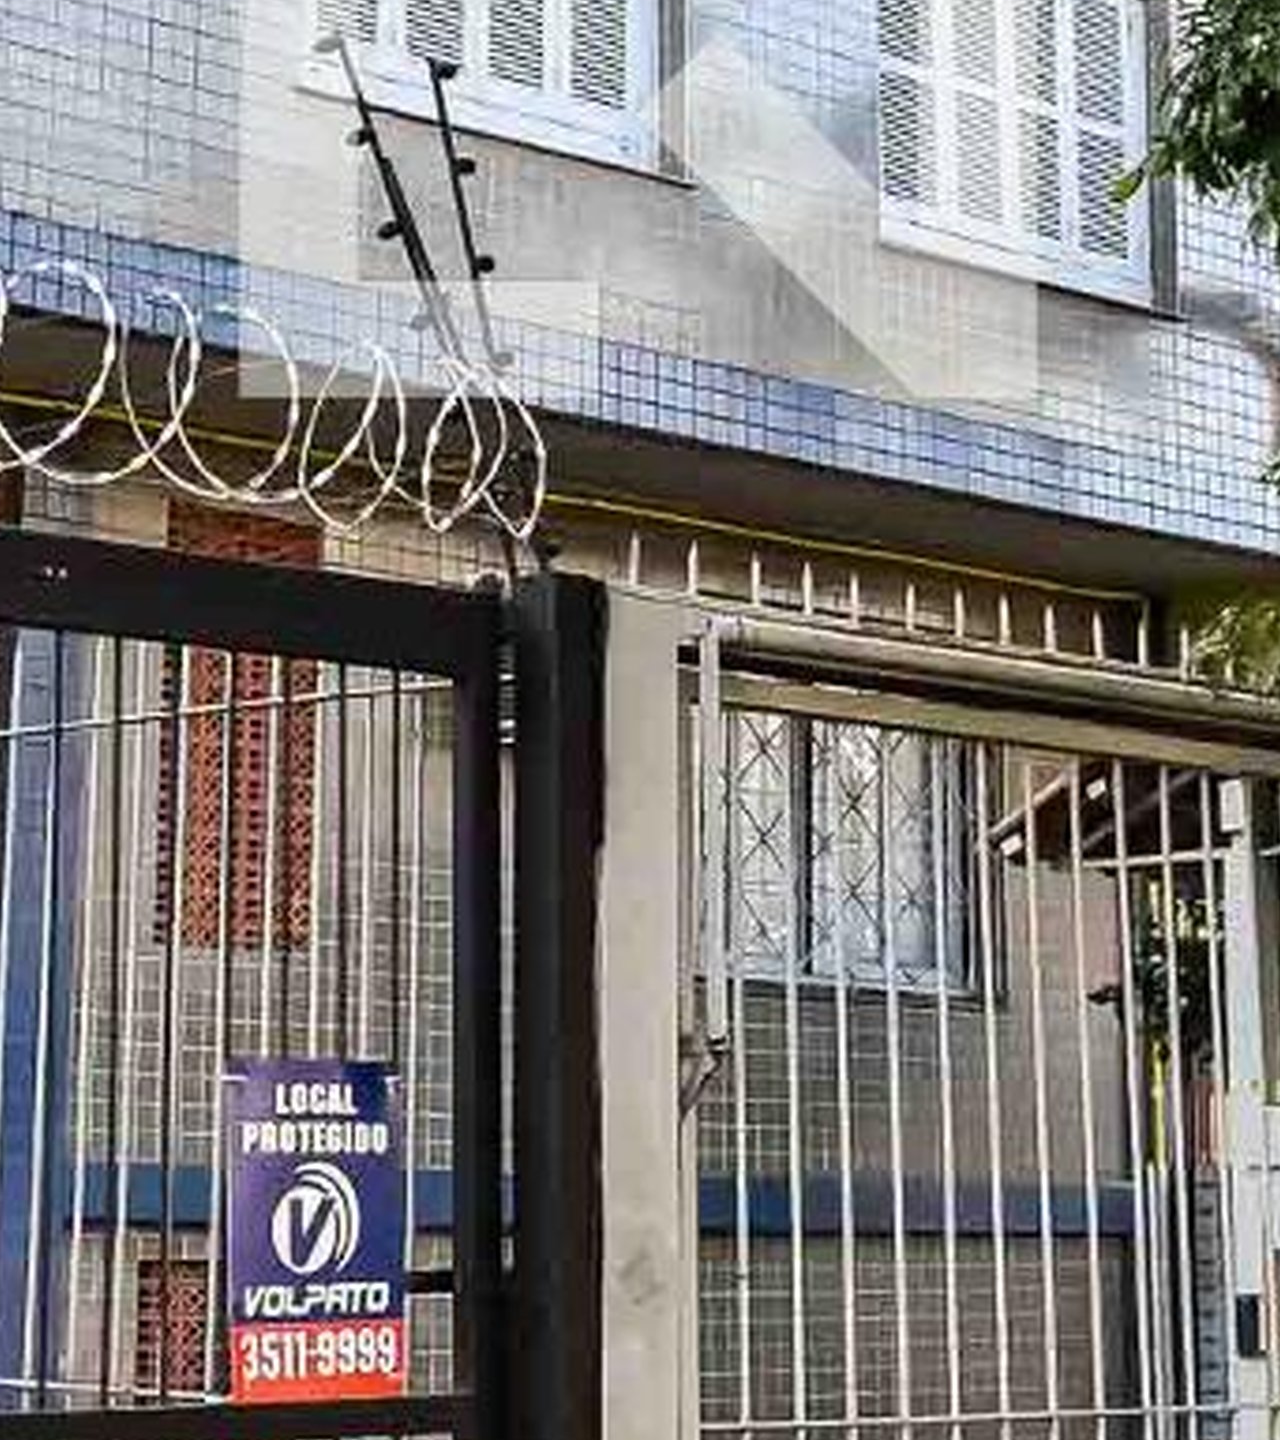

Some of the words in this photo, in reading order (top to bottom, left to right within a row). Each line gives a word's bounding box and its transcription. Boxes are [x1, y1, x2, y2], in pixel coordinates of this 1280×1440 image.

[275, 1082, 359, 1115] LOCAL
[242, 1120, 389, 1155] PROTEGIDO
[244, 1280, 390, 1317] VOLPATO
[240, 1326, 398, 1381] 3511-9999
